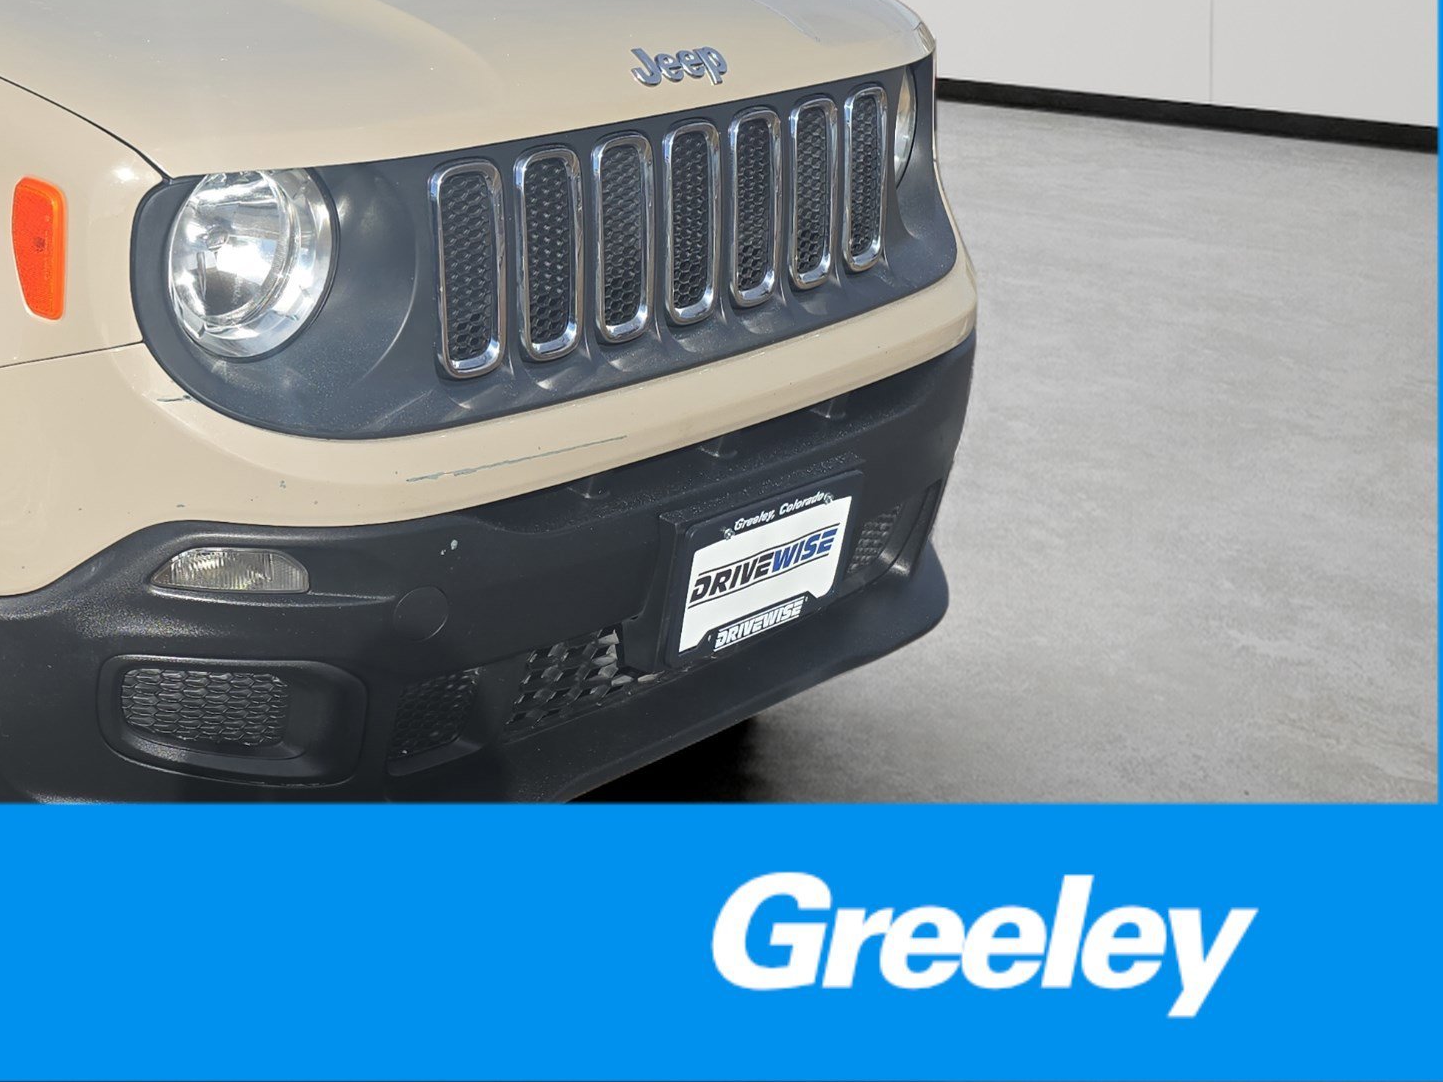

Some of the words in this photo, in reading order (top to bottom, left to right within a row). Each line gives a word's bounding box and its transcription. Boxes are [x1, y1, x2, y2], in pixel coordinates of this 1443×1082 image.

[630, 45, 728, 86] Jeep
[779, 491, 825, 516] Colorado
[689, 527, 839, 604] DRIVEWISE
[714, 598, 805, 649] DRIVEWISE
